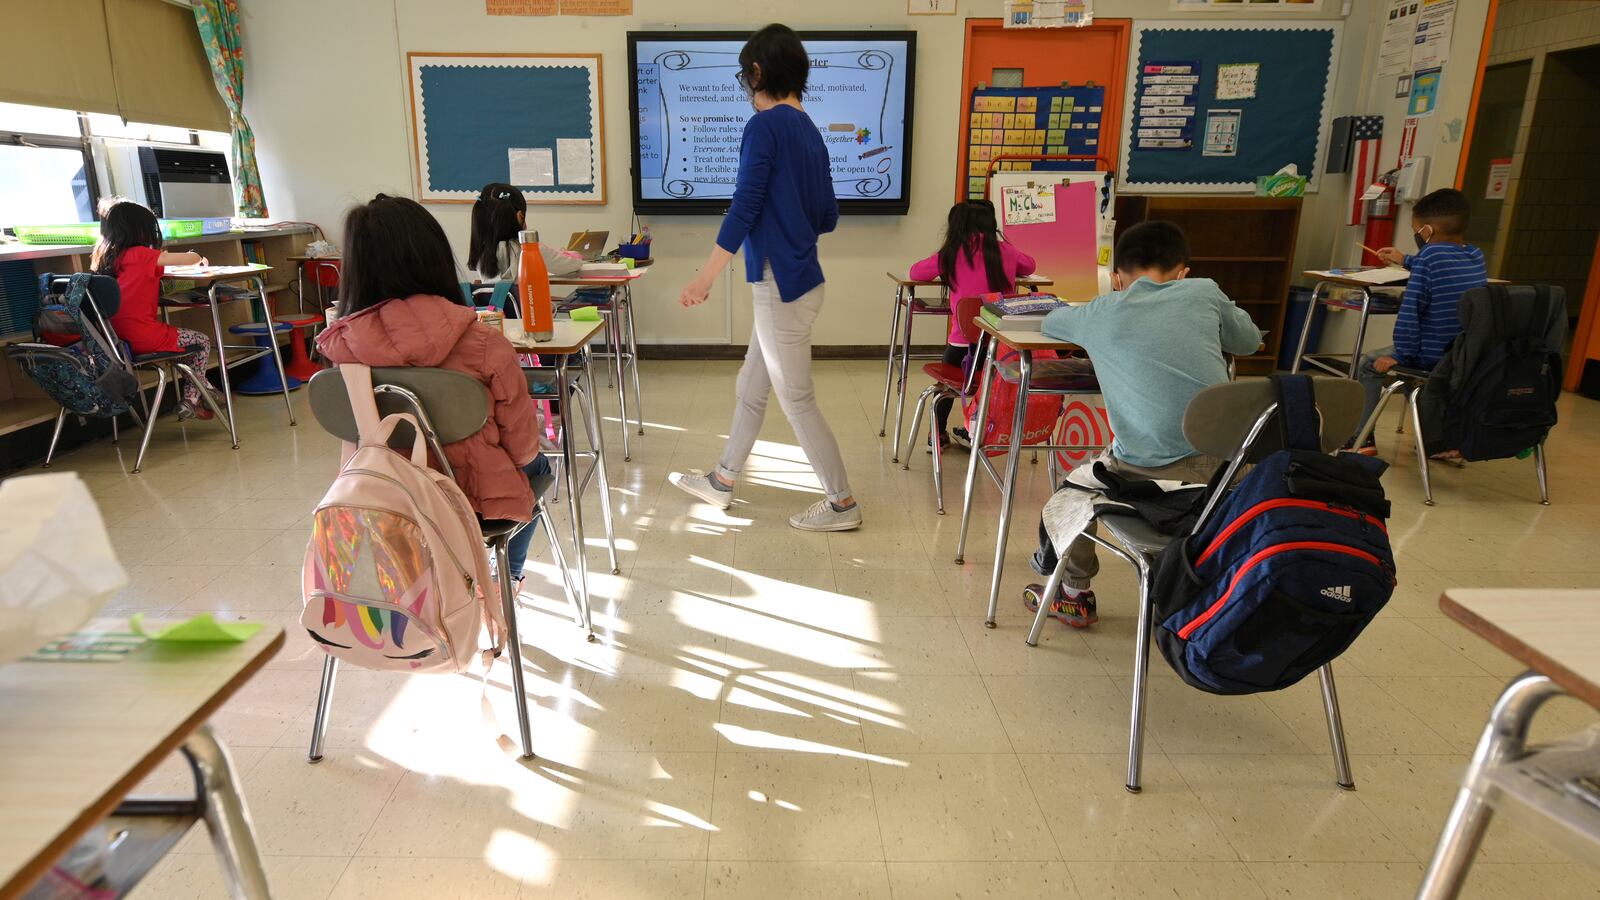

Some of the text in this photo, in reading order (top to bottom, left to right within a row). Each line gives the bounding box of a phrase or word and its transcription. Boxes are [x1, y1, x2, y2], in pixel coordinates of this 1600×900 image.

[679, 84, 691, 92] We
[712, 84, 720, 92] to
[721, 84, 735, 92] feel
[827, 84, 867, 93] motivated,
[679, 94, 719, 103] interested,
[720, 94, 735, 102] and
[680, 115, 689, 123] So
[703, 115, 734, 124] promise
[693, 135, 721, 143] Include
[825, 135, 855, 144] Together
[693, 145, 725, 154] Everyone
[694, 155, 713, 163] Treat
[714, 155, 738, 163] others
[694, 165, 703, 173] Be
[704, 165, 731, 173] flexible
[710, 175, 729, 183] ideas
[1319, 588, 1353, 603] adidas
